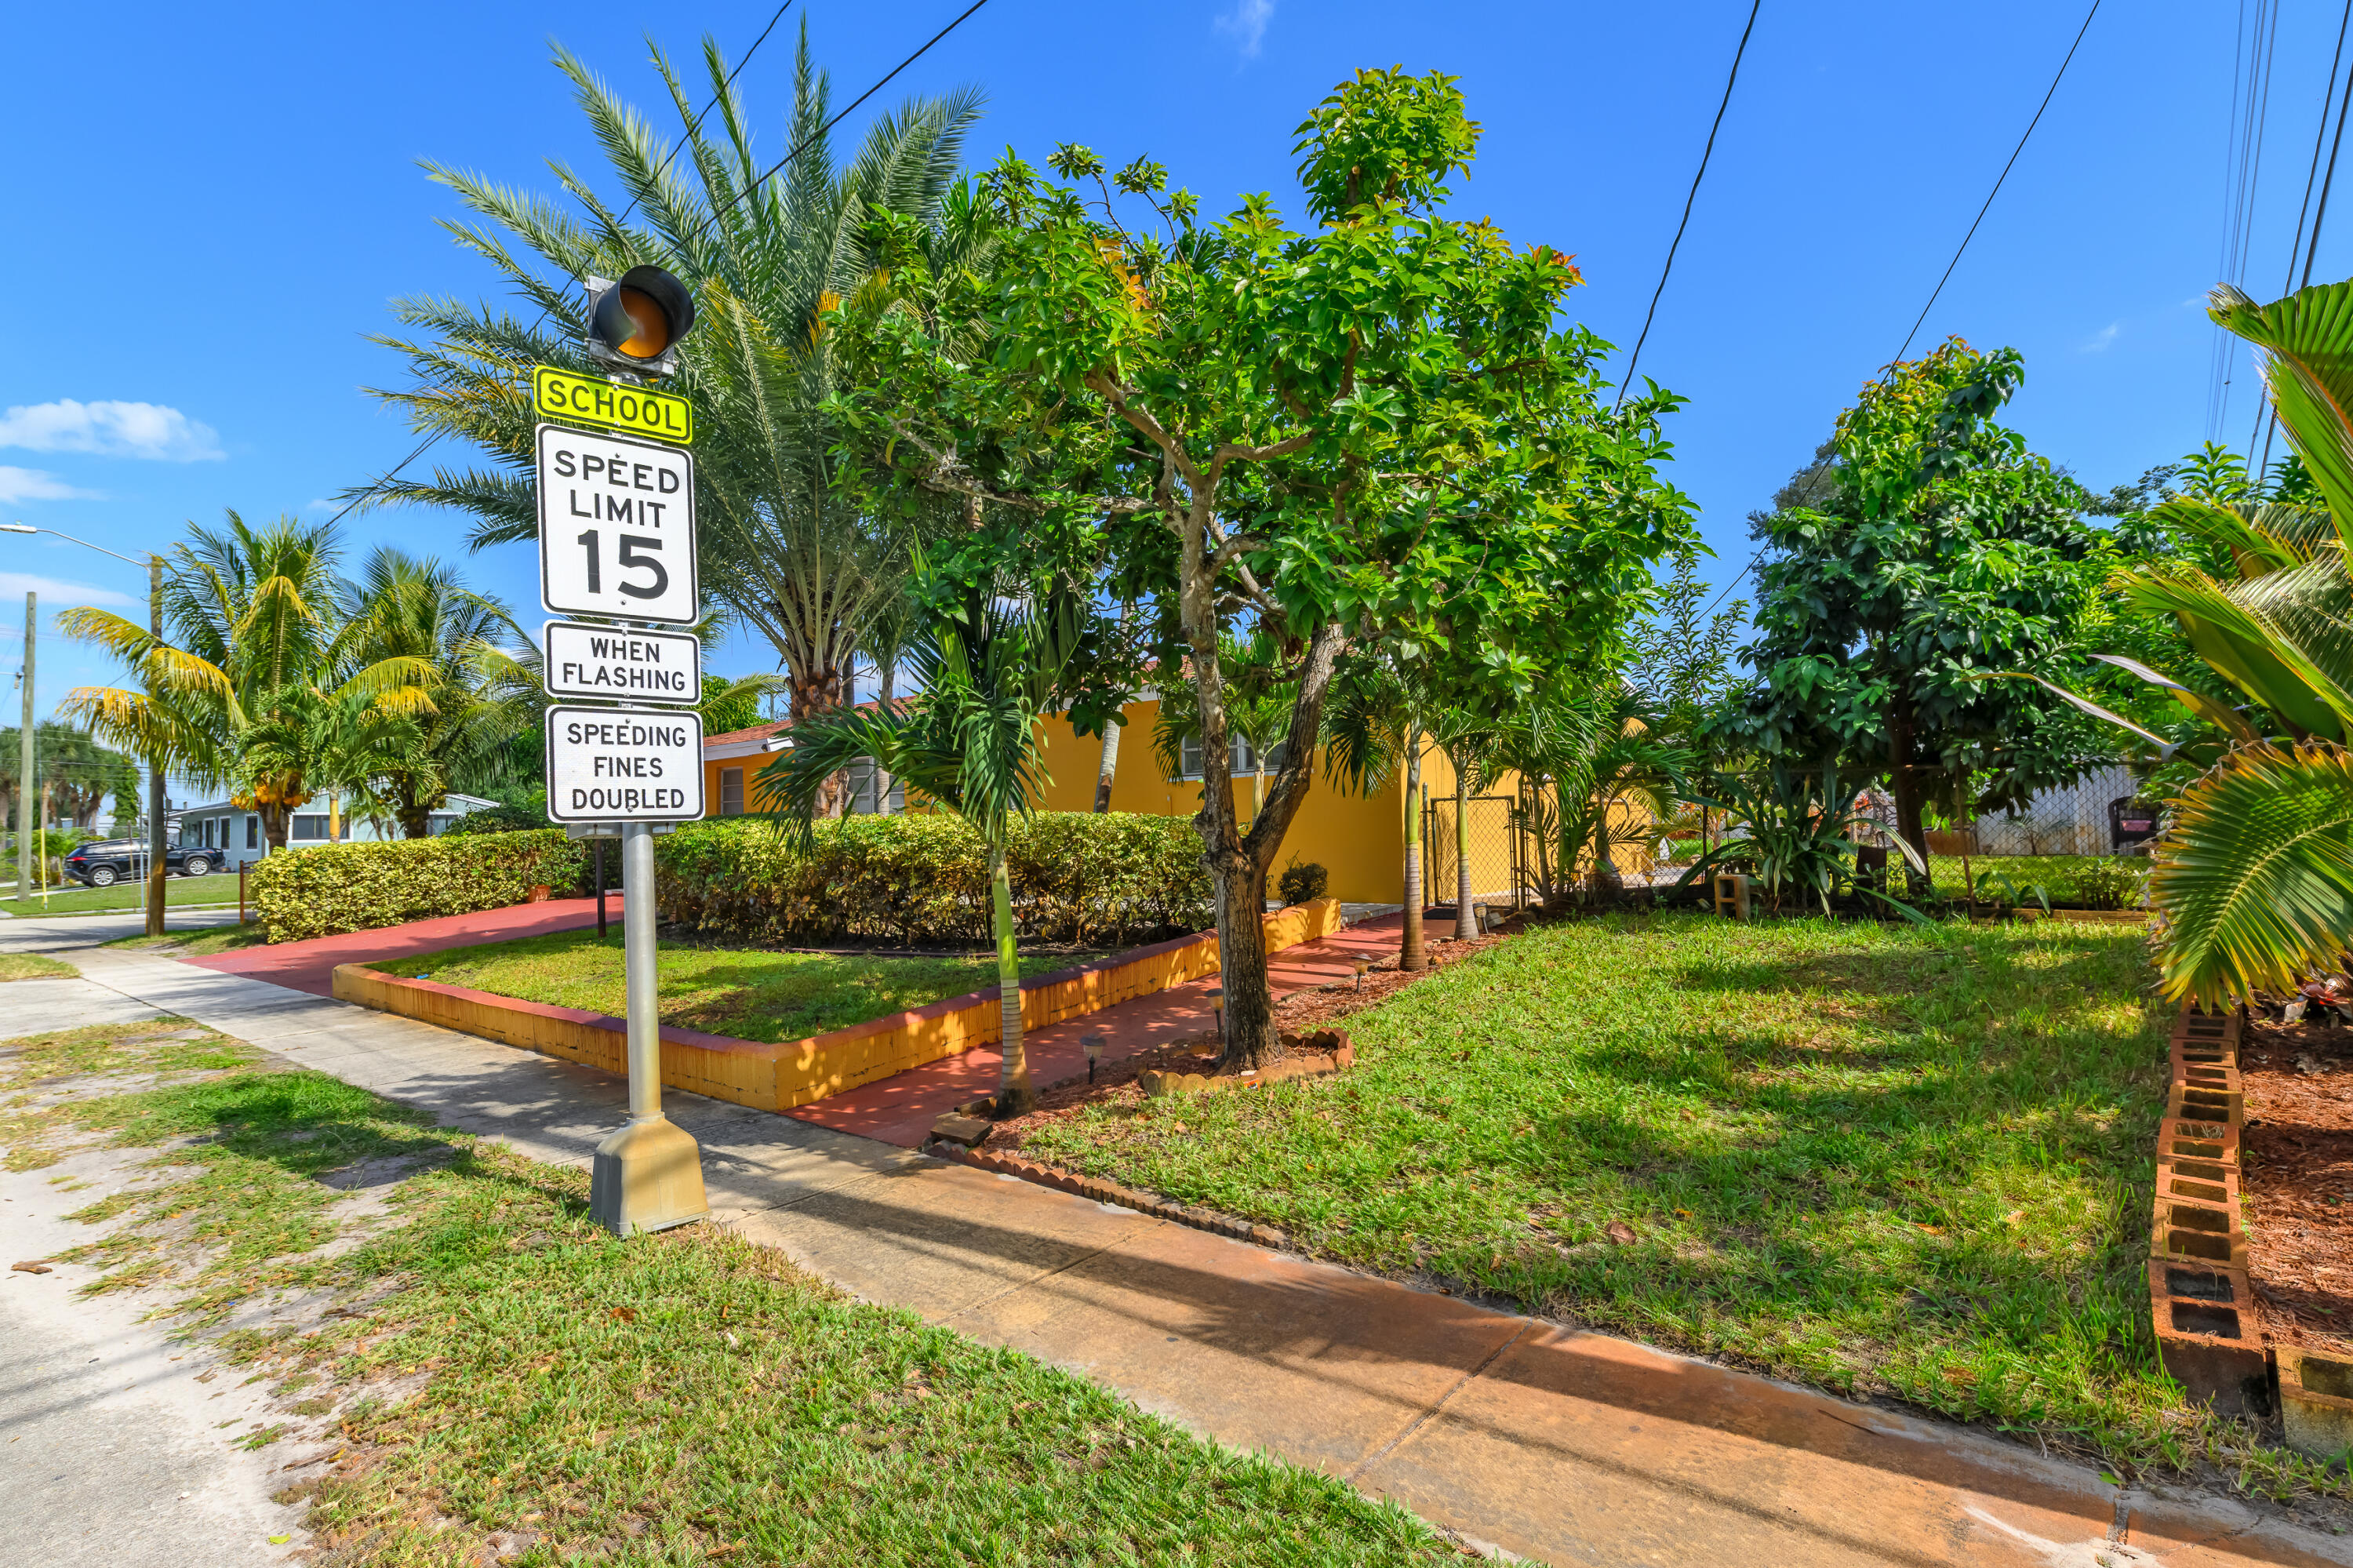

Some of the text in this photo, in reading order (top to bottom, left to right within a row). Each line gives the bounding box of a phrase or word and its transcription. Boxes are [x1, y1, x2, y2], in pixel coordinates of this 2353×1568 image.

[547, 379, 682, 433] SCHOOL
[553, 449, 680, 495] SPEED
[570, 489, 667, 528] LIMIT
[577, 529, 670, 599] 15
[591, 636, 660, 663] WHEN
[562, 662, 686, 692] FLASHING
[567, 722, 686, 748] SPEEDING
[594, 756, 664, 778] FINES
[572, 788, 685, 809] DOUBLED
